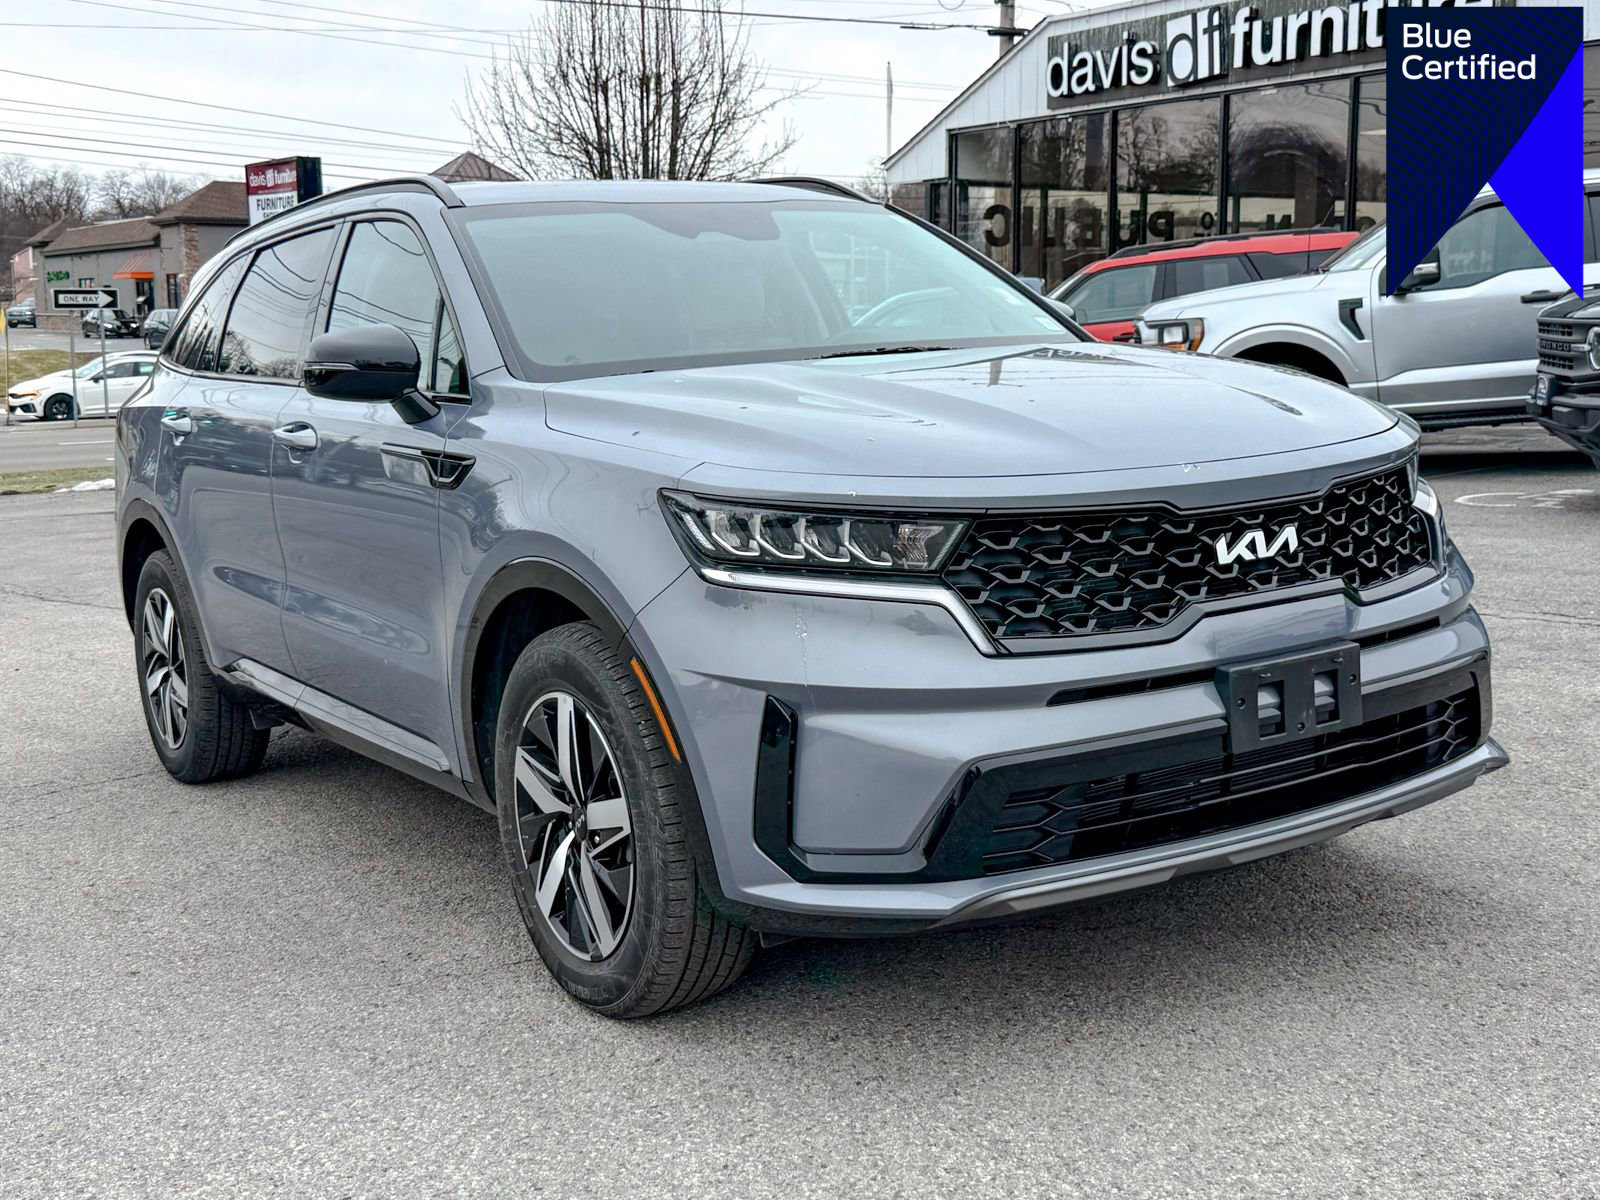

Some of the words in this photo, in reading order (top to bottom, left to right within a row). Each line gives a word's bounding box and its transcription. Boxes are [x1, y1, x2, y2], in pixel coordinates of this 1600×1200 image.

[1045, 30, 1156, 99] davis
[1231, 0, 1493, 69] furnit
[249, 172, 267, 187] davis
[256, 195, 295, 211] FURNITURE
[1539, 340, 1570, 351] RONCO
[1215, 525, 1299, 565] KIA
